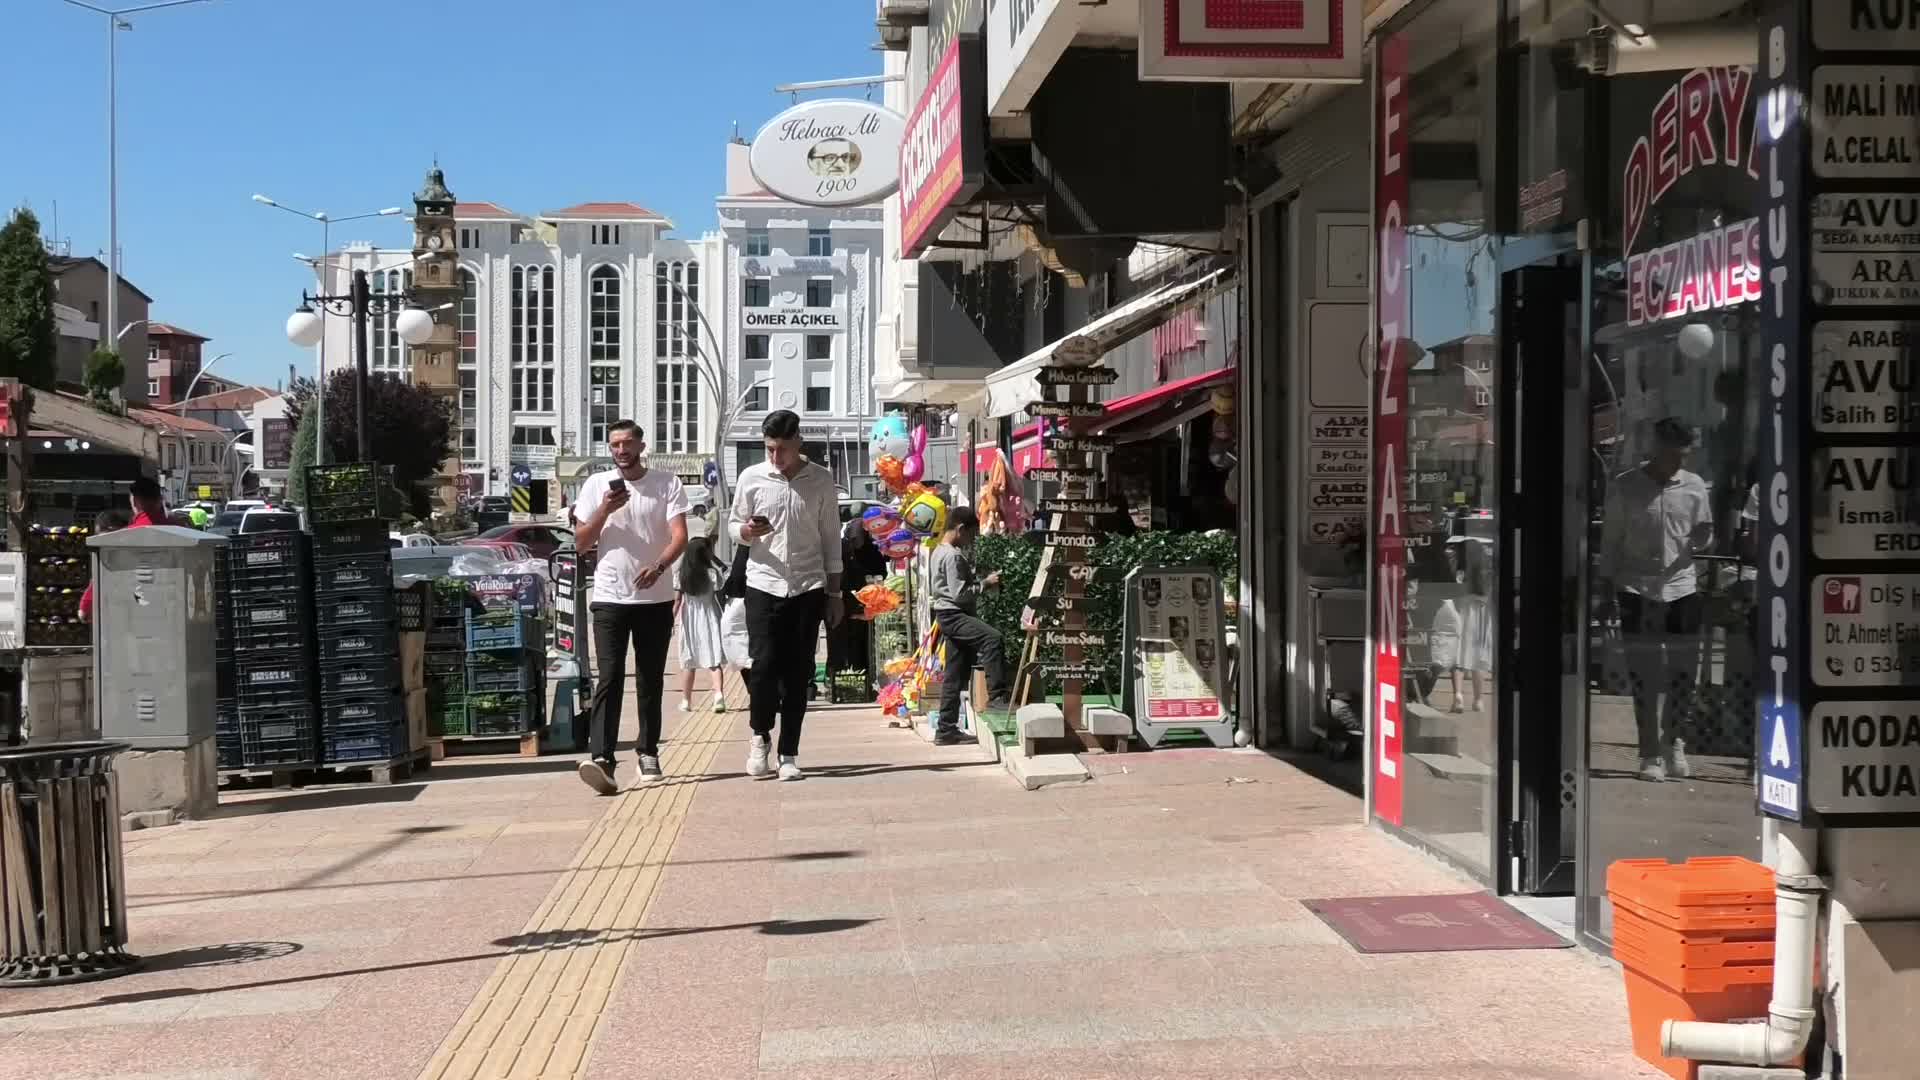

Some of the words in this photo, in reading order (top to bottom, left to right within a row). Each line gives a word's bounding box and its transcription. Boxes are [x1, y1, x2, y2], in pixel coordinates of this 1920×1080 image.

[1823, 75, 1886, 118] MALİ
[1896, 83, 1920, 118] M
[1824, 136, 1913, 164] A.CELAL
[1623, 65, 1761, 261] DERY
[1768, 25, 1787, 318] BULUT
[815, 177, 857, 198] 1900
[746, 312, 787, 326] ÖMER
[790, 314, 839, 328] AÇIKEL
[1821, 405, 1876, 424] Salih
[1380, 76, 1401, 778] ECZANE
[1045, 533, 1097, 548] Limonata
[1055, 597, 1074, 610] Su
[1870, 586, 1905, 608] DİŞ
[1847, 622, 1893, 644] Ahmet
[1841, 763, 1920, 797] KUA
